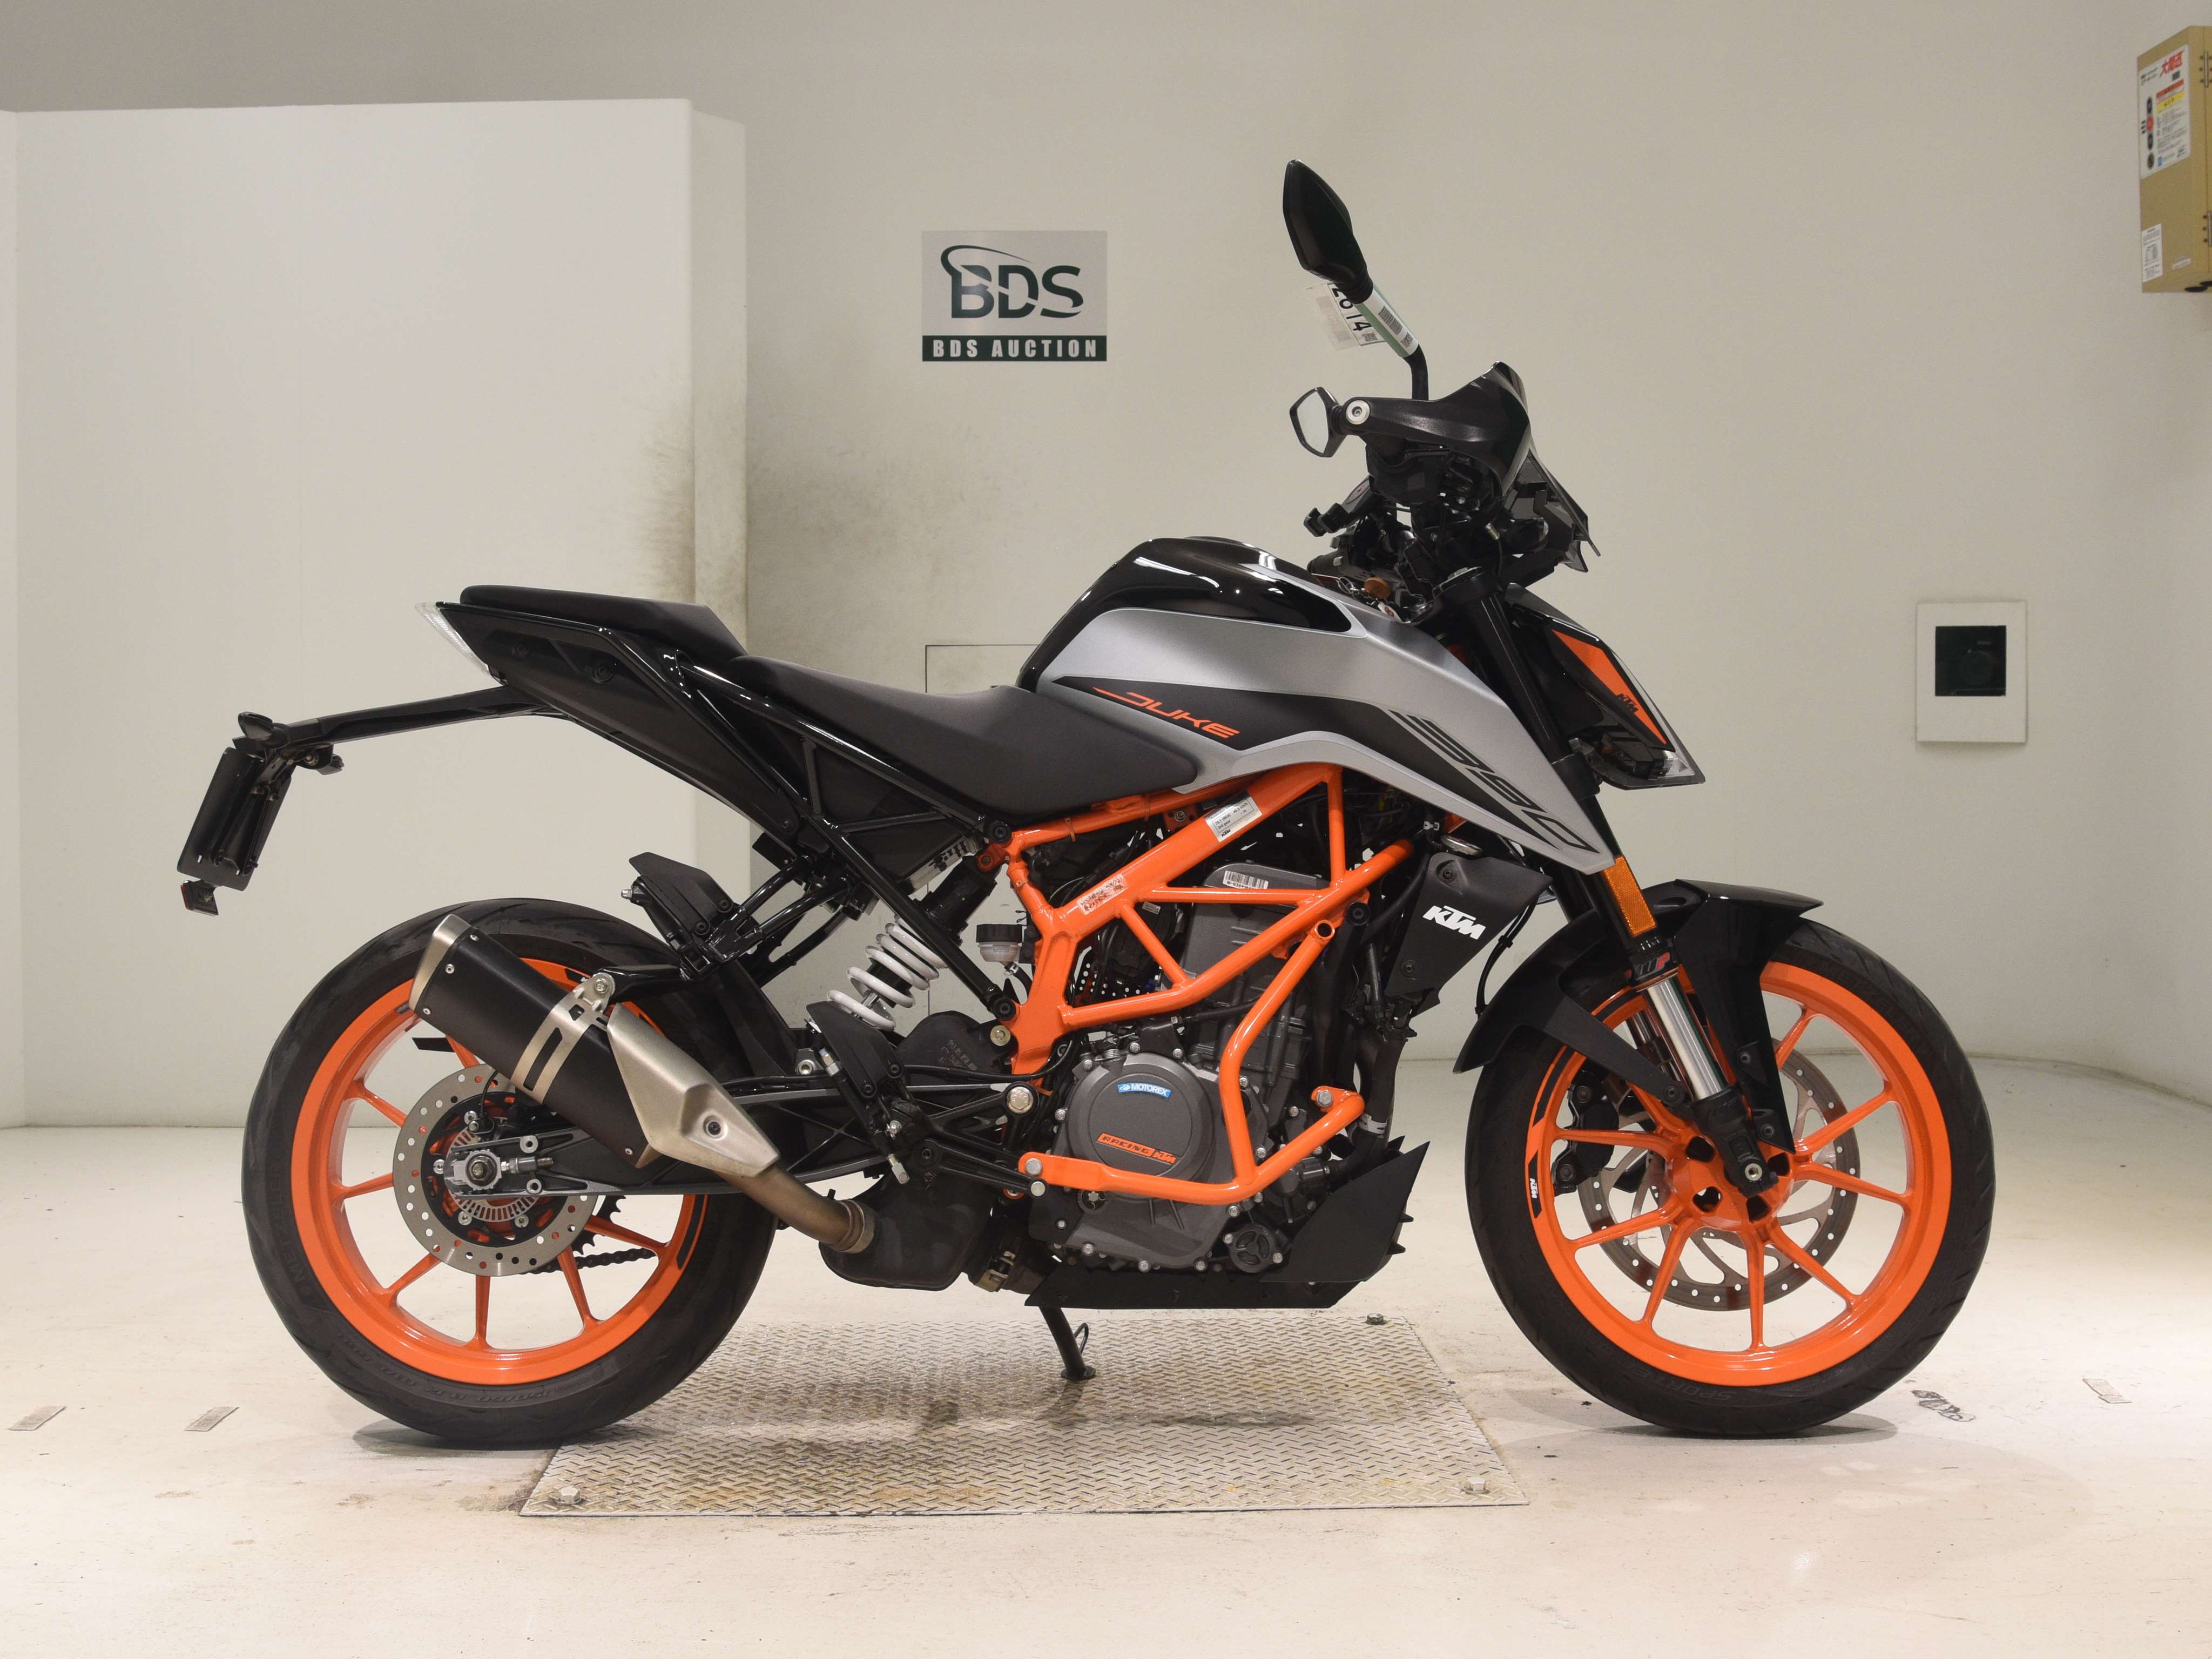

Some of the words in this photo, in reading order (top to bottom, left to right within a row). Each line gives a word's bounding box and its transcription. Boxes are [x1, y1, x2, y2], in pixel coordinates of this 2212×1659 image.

[941, 245, 1083, 318] BDS
[933, 340, 978, 358] BDS
[992, 340, 1096, 358] AUCTION
[1093, 687, 1240, 738] DUKE
[1617, 693, 1638, 713] KTM
[1388, 709, 1600, 853] 390
[1422, 905, 1486, 940] KTM
[1131, 1083, 1167, 1097] MOTOREX
[1103, 1136, 1150, 1154] RACING
[1152, 1150, 1176, 1164] KTM
